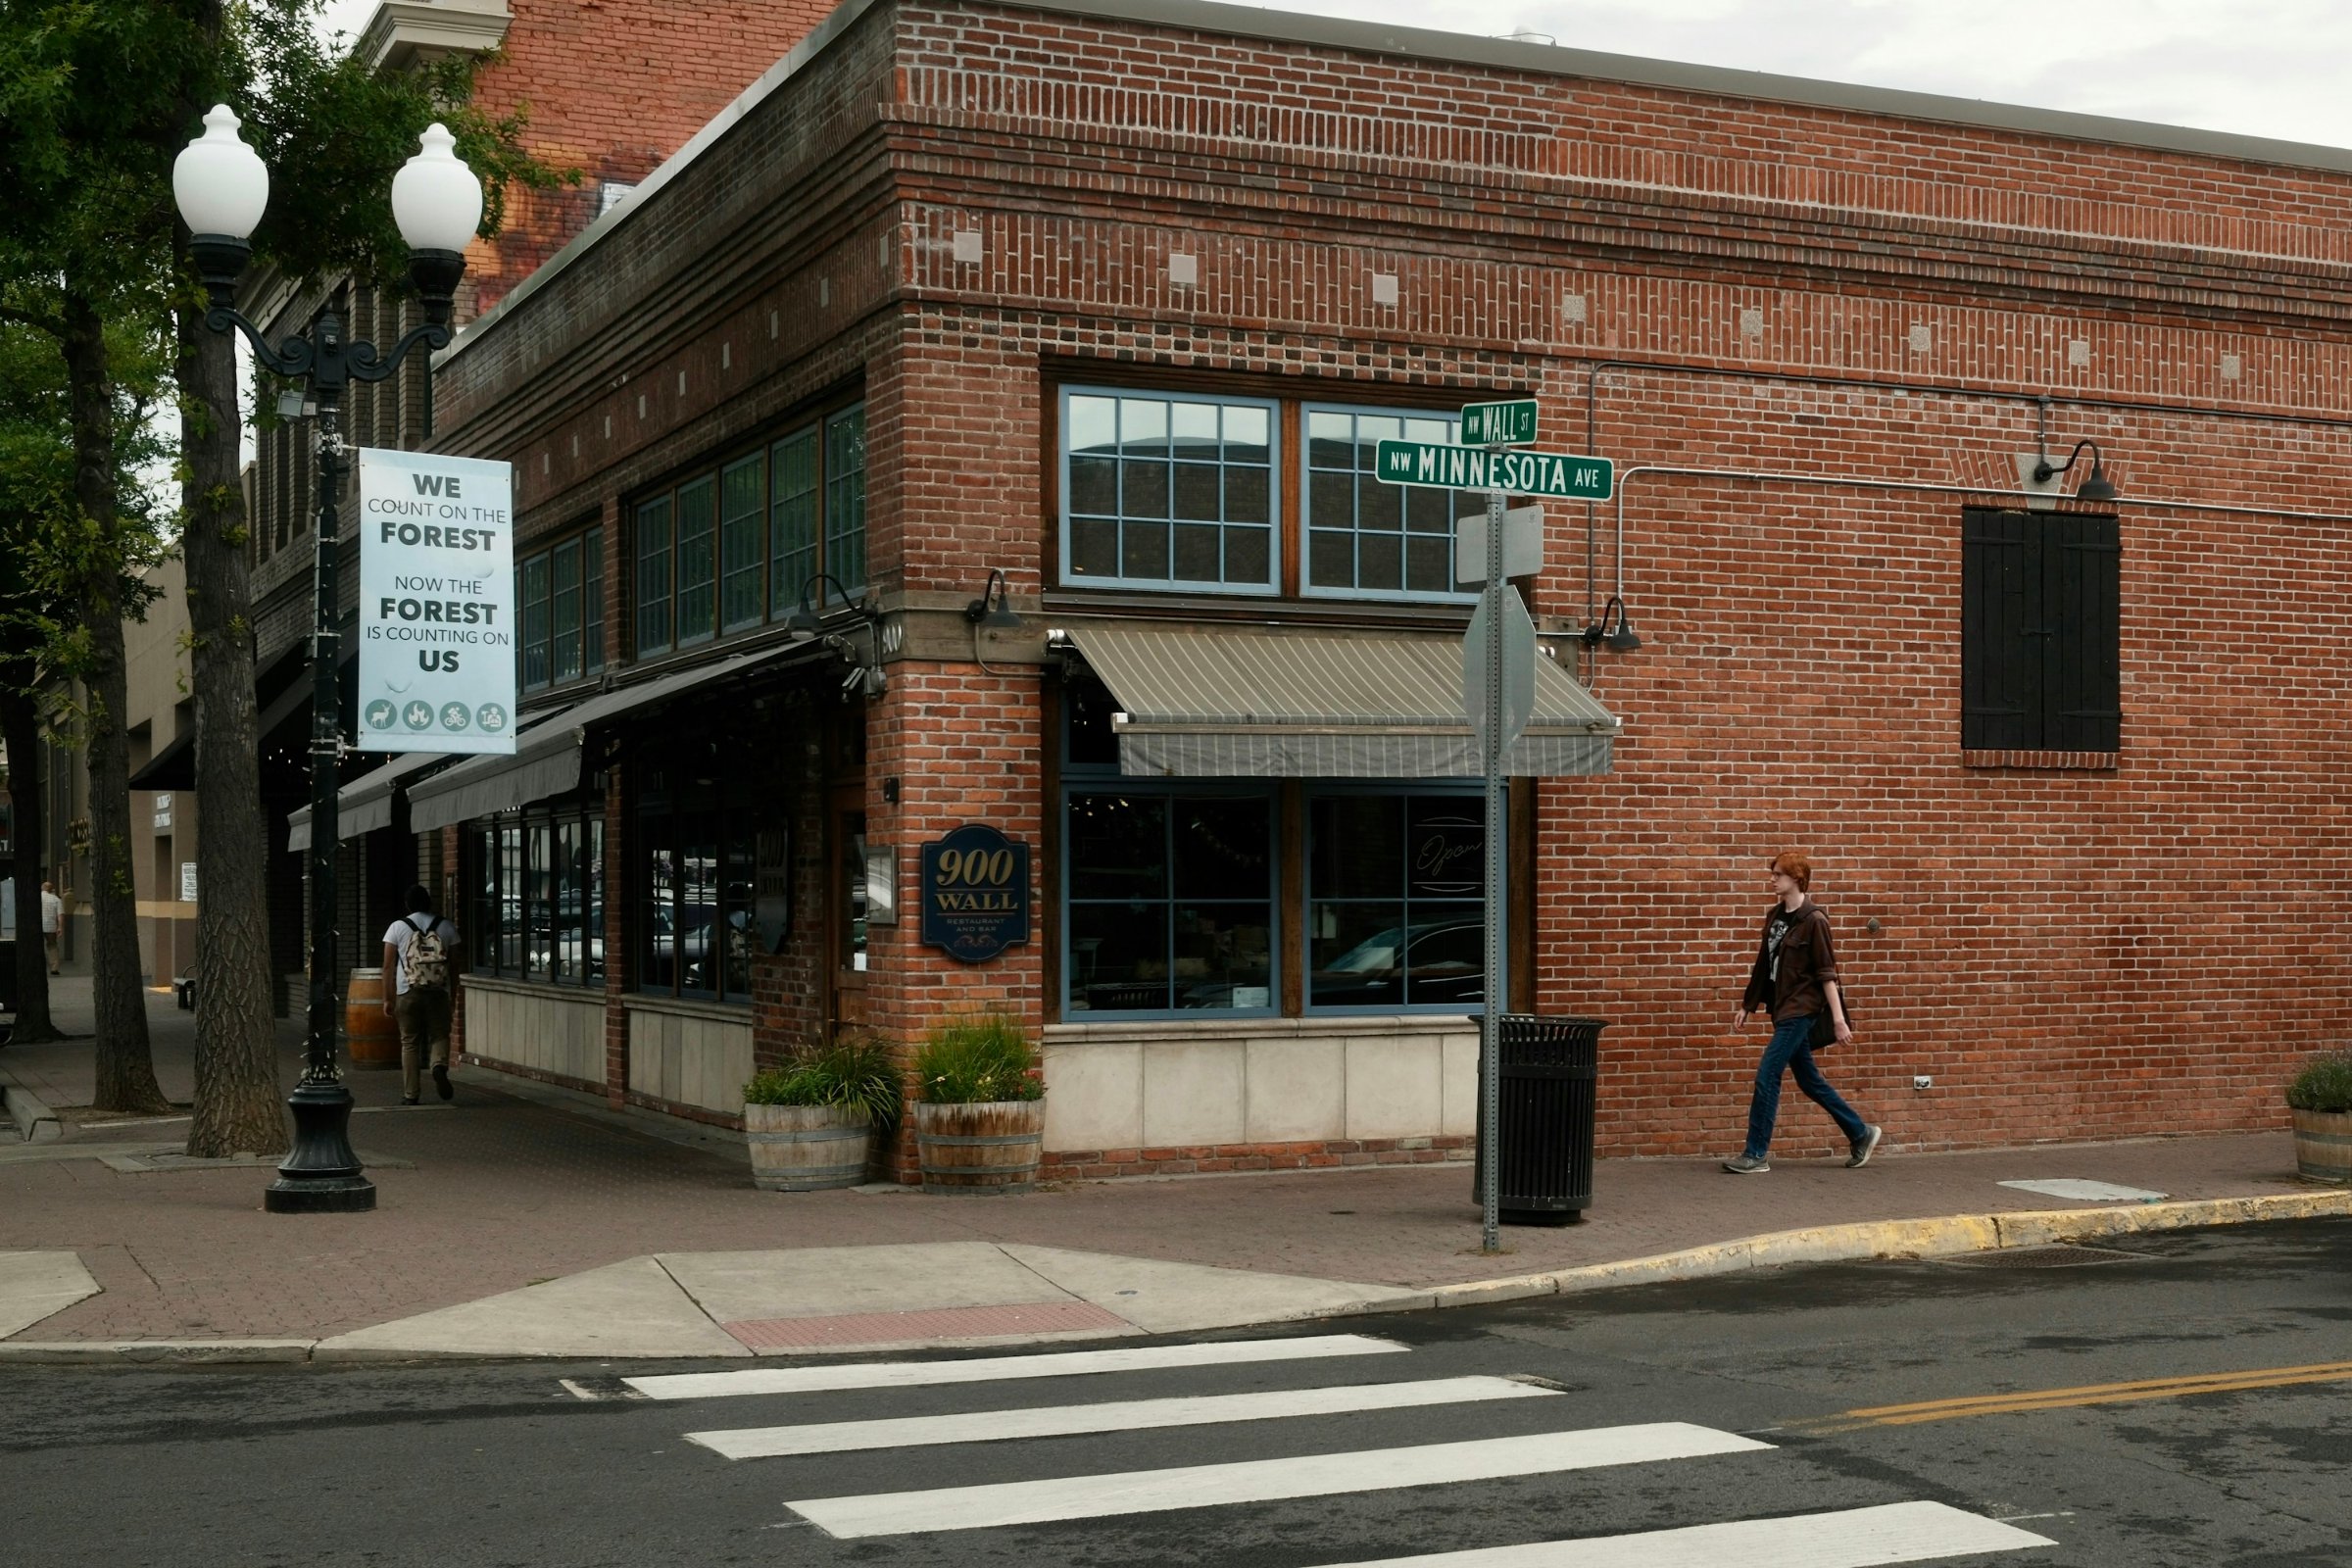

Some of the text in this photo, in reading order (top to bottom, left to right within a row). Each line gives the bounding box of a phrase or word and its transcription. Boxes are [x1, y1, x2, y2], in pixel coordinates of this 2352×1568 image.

[1468, 405, 1530, 442] NW WALL ST
[1391, 446, 1599, 493] NW MINNESOTA AVE
[413, 473, 461, 498] WE
[368, 498, 507, 523] COUNT ON THE
[380, 522, 496, 551] FOREST
[395, 576, 482, 594] NOW THE
[380, 598, 498, 624] FOREST
[368, 626, 509, 645] IS COUNTING ON
[883, 622, 902, 655] 900
[418, 650, 460, 672] US
[936, 849, 1014, 886] 900
[1417, 834, 1483, 877] Open
[935, 893, 1018, 910] WALL
